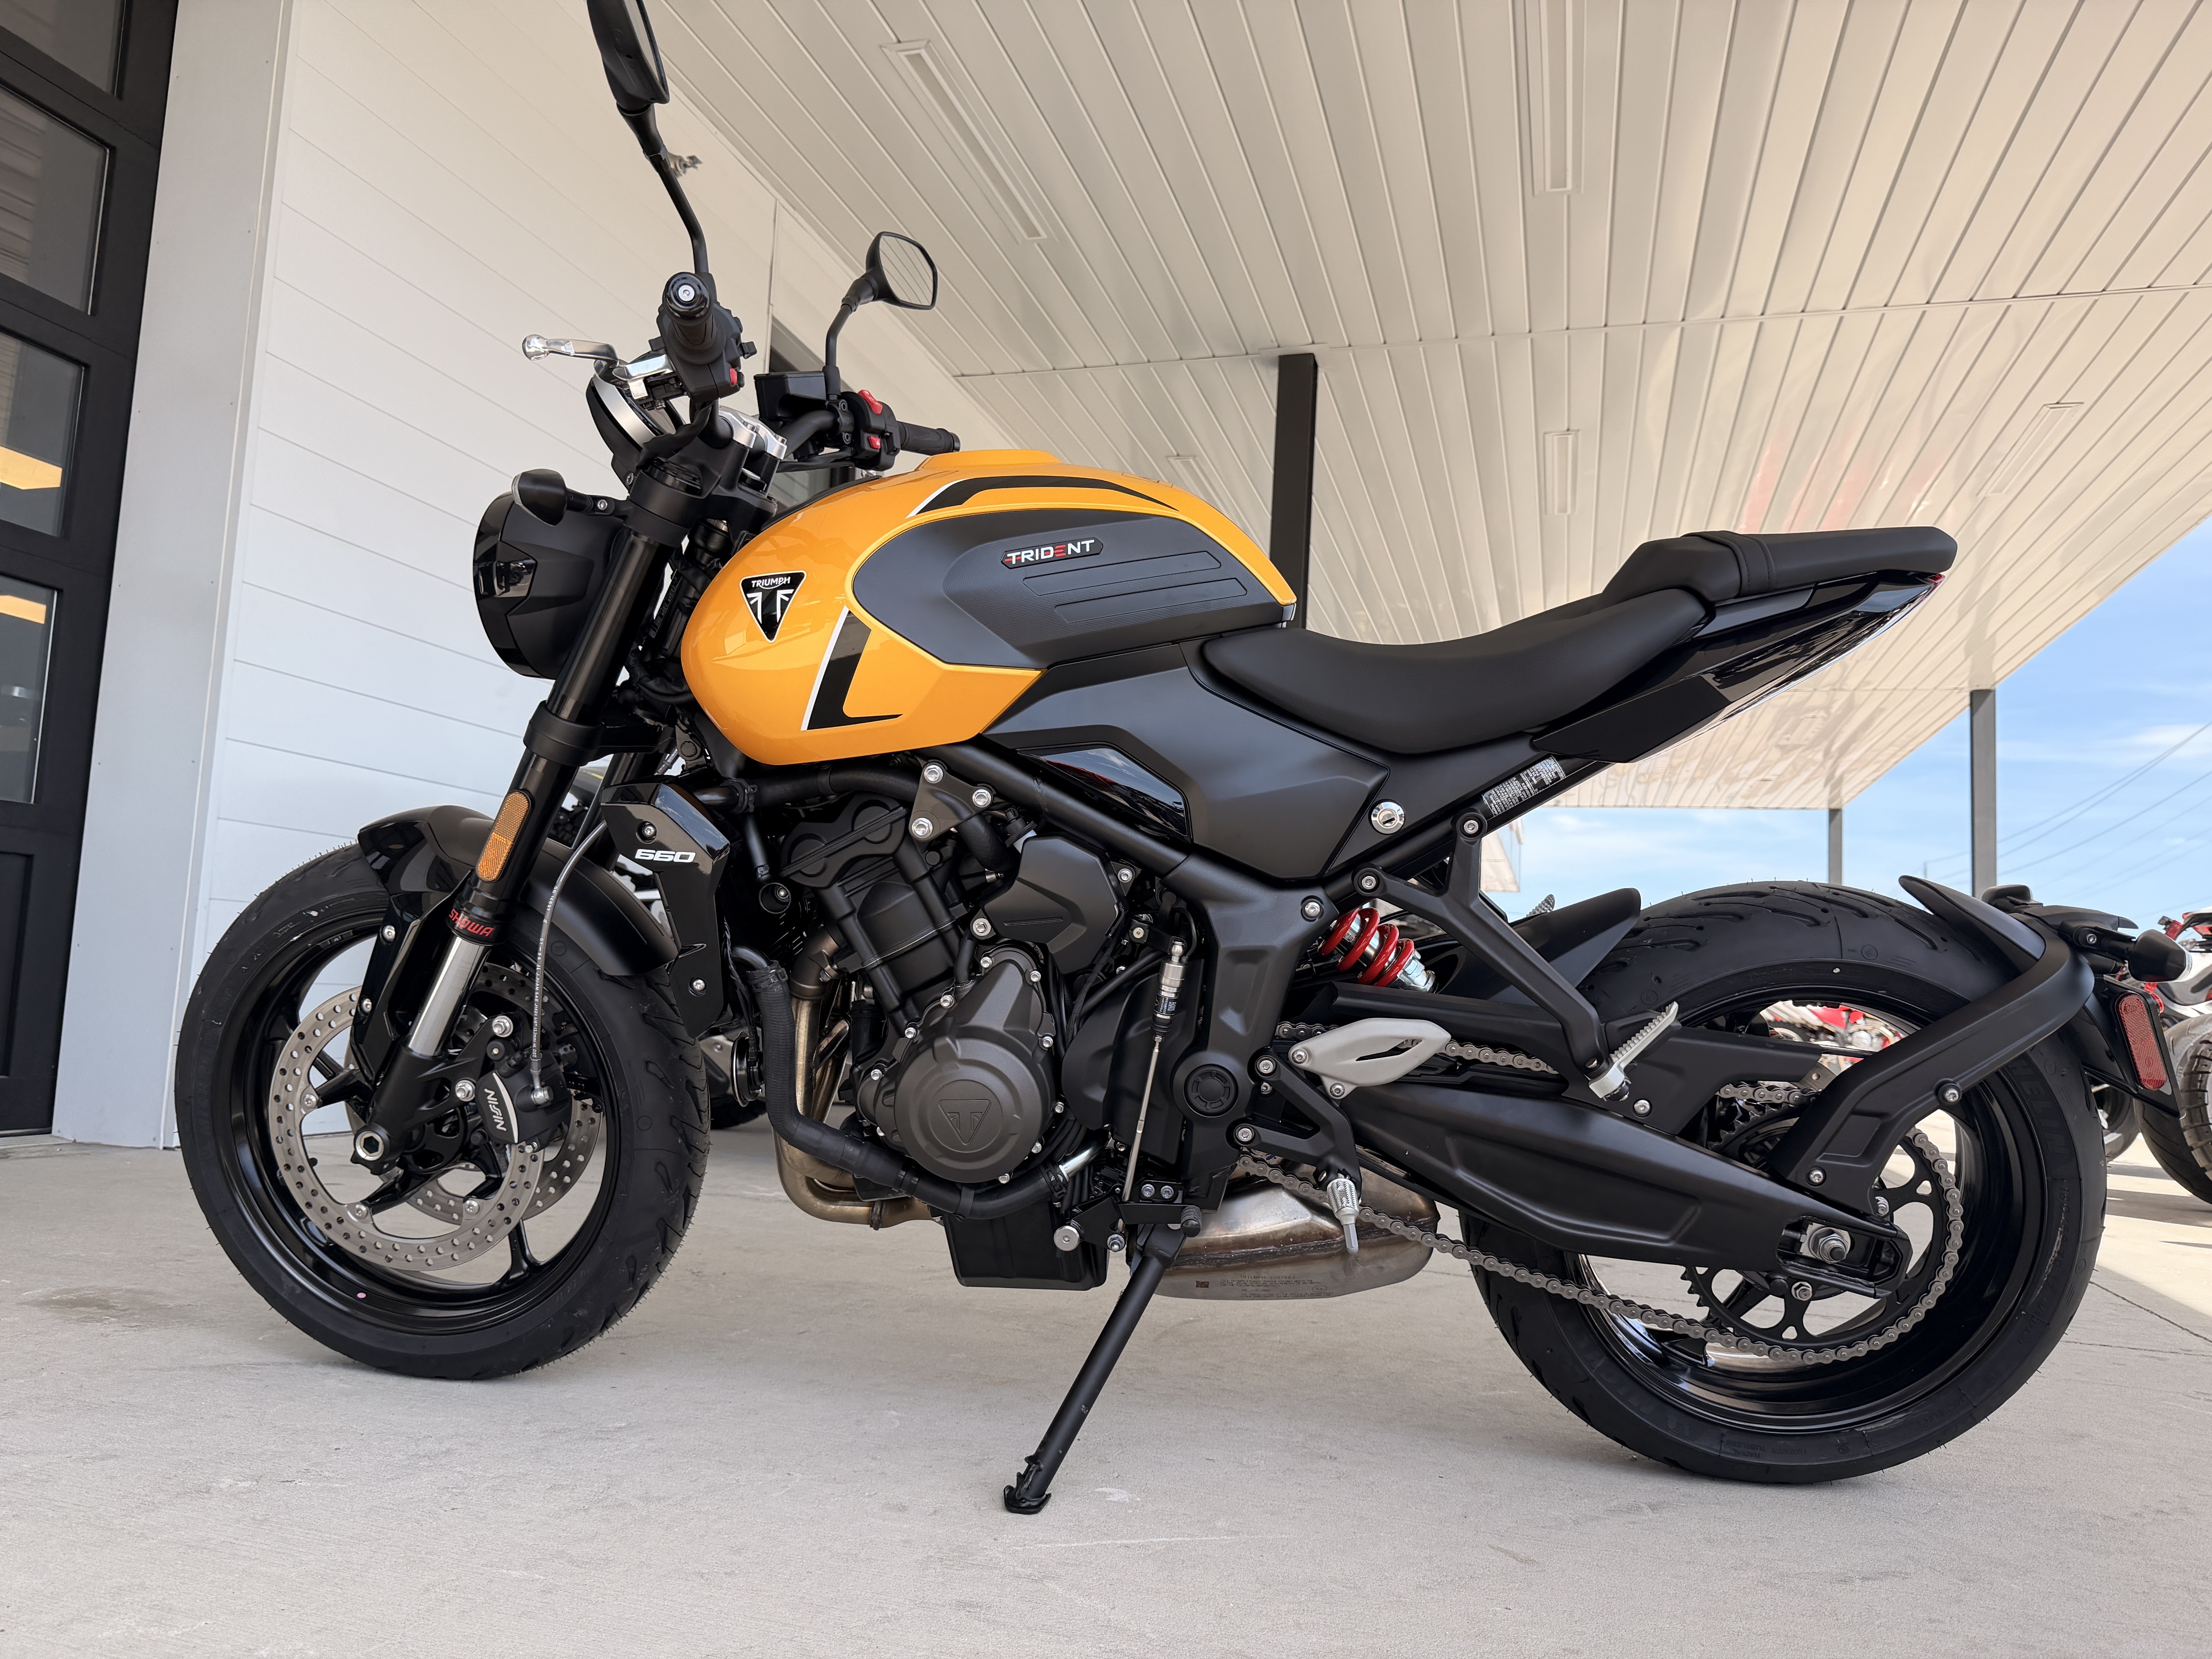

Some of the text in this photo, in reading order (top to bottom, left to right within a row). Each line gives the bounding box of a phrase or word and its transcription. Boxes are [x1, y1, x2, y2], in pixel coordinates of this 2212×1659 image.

[1006, 539, 1095, 565] TRIDENT
[751, 576, 790, 589] TRIUMPH
[635, 848, 696, 863] 660
[449, 909, 494, 937] SHOWA
[484, 1089, 507, 1131] NISSIN
